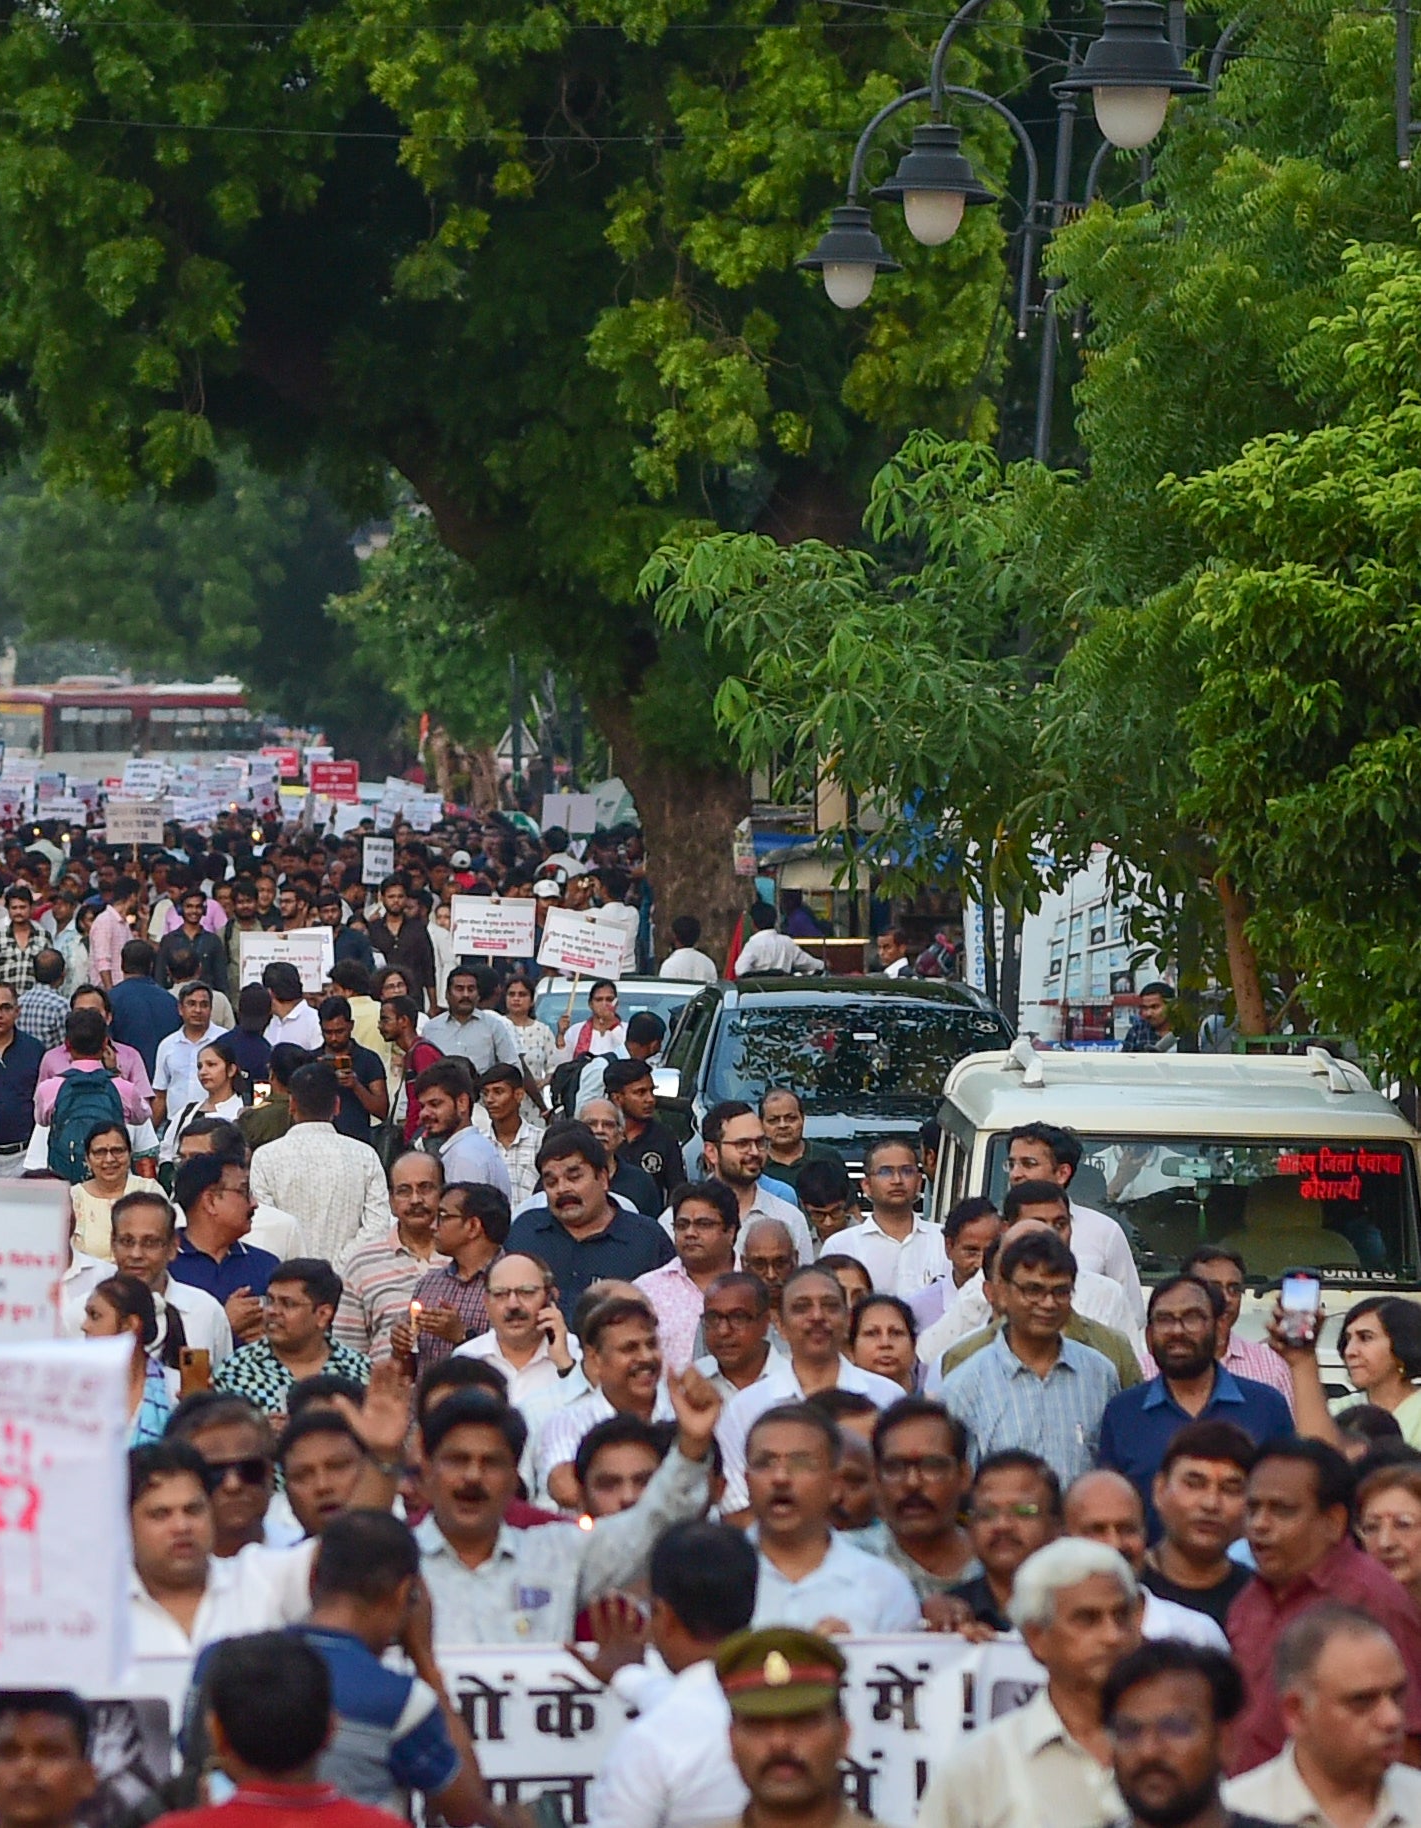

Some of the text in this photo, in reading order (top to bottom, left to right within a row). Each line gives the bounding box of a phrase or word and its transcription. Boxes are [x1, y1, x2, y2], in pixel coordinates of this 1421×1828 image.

[1319, 1146, 1355, 1174] जिला
[527, 1673, 603, 1739] के
[865, 1663, 930, 1731] में
